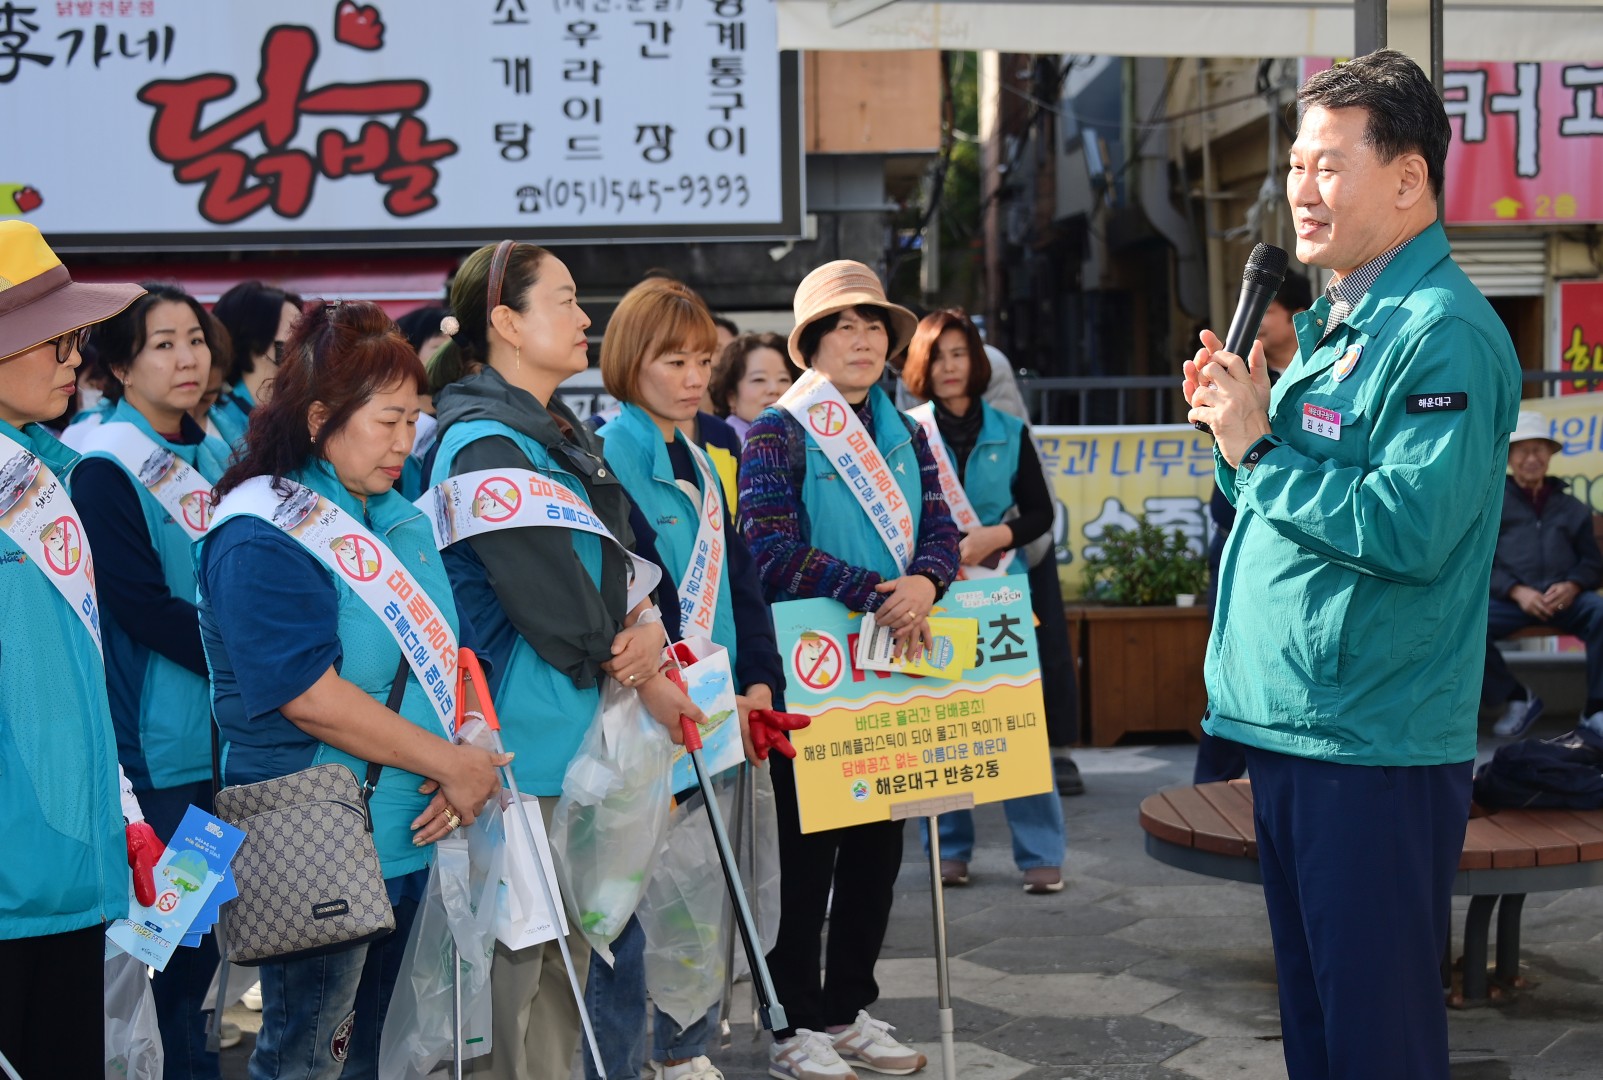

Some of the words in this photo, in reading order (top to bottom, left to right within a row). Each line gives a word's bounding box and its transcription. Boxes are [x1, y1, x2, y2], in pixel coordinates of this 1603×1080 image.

[136, 24, 457, 224] 닭발
[634, 20, 676, 164] 간장
[545, 174, 751, 215] (051)545-9393
[1418, 396, 1452, 408] 해운대구
[837, 452, 877, 504] 아름다운
[870, 501, 899, 541] 해운대
[846, 430, 902, 513] 담배꽁초
[686, 540, 709, 597] 아름다운
[695, 538, 722, 630] 담배꽁초
[386, 570, 456, 675] 담배꽁초
[383, 601, 430, 667] 아름다운
[424, 664, 454, 716] 해운대
[803, 743, 827, 763] 해양
[830, 731, 908, 758] 미세플라스틱이
[911, 727, 933, 746] 되어
[936, 723, 969, 743] 물고기
[971, 718, 1003, 737] 먹이가
[1006, 711, 1037, 732] 됩니다
[855, 711, 892, 732] 바다로
[934, 698, 986, 721] 담배꽁초!
[841, 755, 891, 778] 담배꽁초
[895, 750, 919, 771] 없는
[922, 742, 970, 765] 아름다운
[972, 737, 1008, 757] 해운대
[876, 769, 940, 796] 해운대구
[943, 759, 1000, 785] 반송2동
